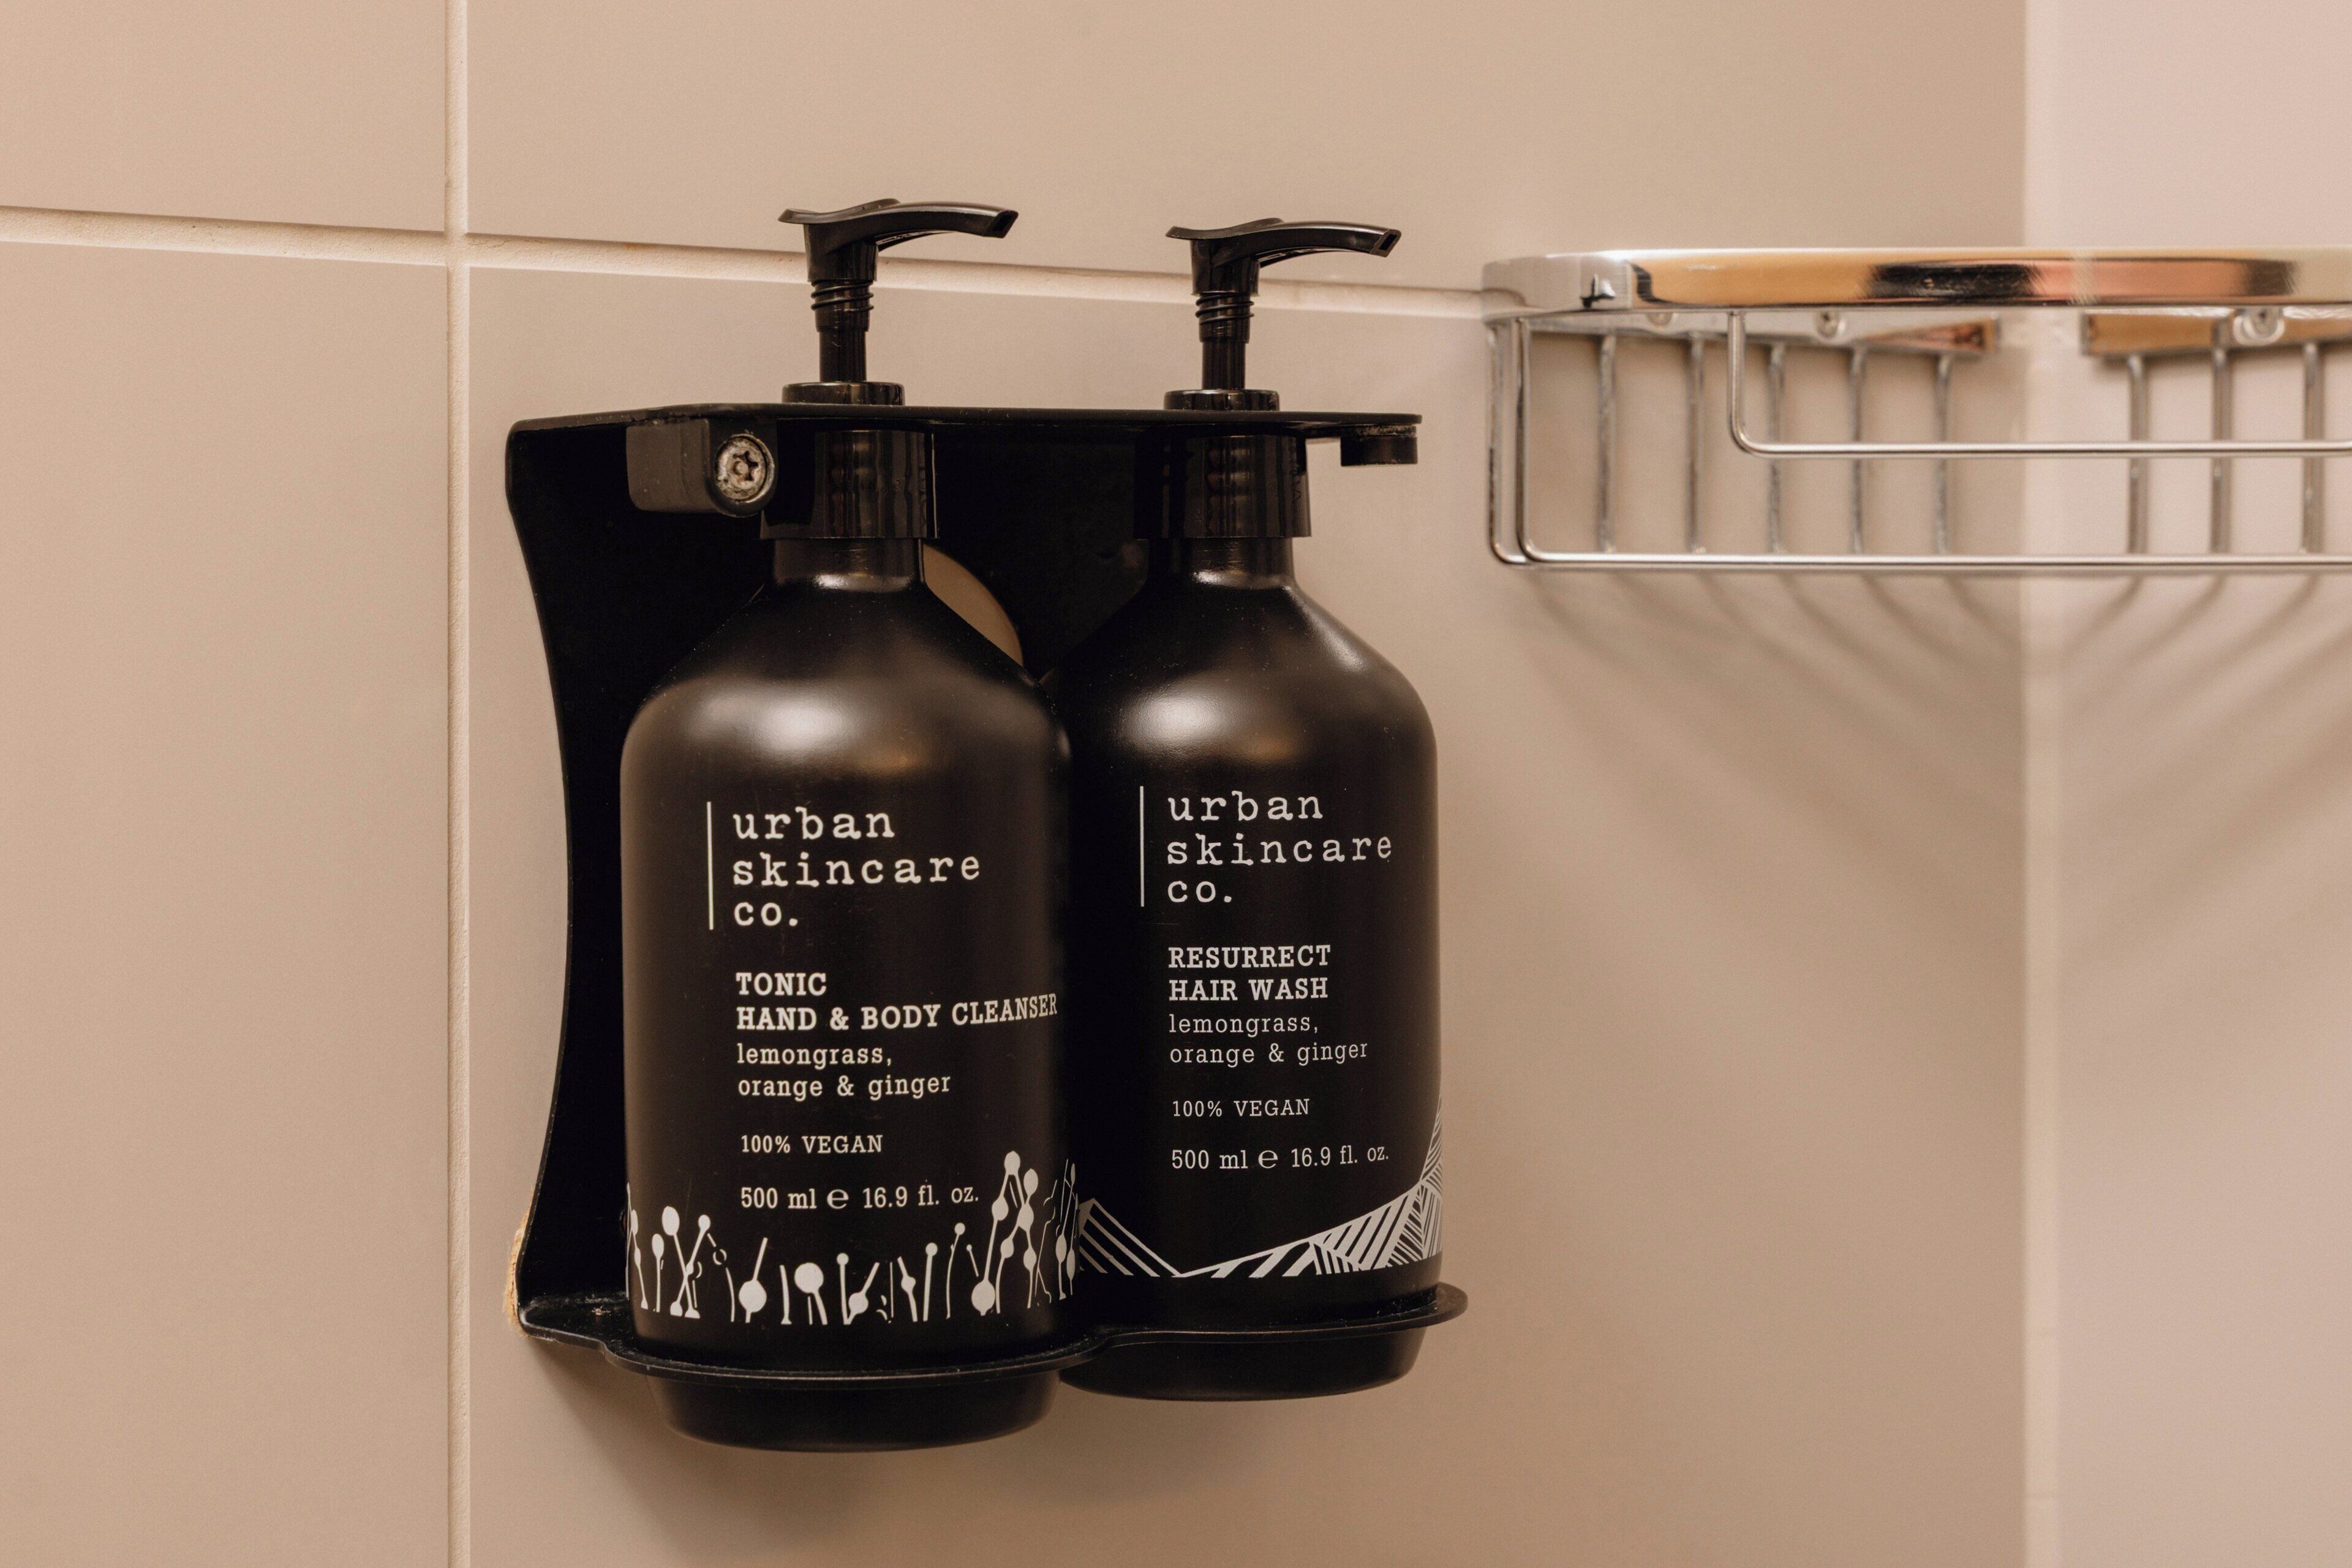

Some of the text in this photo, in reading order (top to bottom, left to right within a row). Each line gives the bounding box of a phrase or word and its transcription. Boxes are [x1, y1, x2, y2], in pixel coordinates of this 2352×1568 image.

[1167, 790, 1323, 821] urban
[732, 806, 895, 840] urban
[1166, 832, 1392, 865] skincare
[732, 851, 979, 888] skincare
[1167, 880, 1232, 903] co.
[733, 902, 798, 927] co.
[1167, 944, 1331, 968] RESURRECT
[735, 972, 827, 997] TONIC
[1168, 977, 1328, 1001] HAIR WASH
[736, 993, 1057, 1031] HAND & BODY CLEANSER
[1168, 1014, 1317, 1038] lemongrass,
[736, 1042, 891, 1070] lemongrass,
[1169, 1042, 1368, 1068] orange & ginger
[737, 1074, 951, 1102] orange & ginger
[1172, 1098, 1310, 1117] 100% VEGAN
[741, 1134, 883, 1154] 100% VEGAN
[1171, 1149, 1209, 1169] 500
[1218, 1150, 1248, 1169] ml
[1291, 1146, 1331, 1167] 16.9
[1339, 1145, 1358, 1164] fl.
[1366, 1146, 1389, 1162] oz.
[741, 1186, 778, 1209] 500
[787, 1188, 817, 1209] ml
[862, 1186, 908, 1208] 16.9
[917, 1185, 940, 1206] fl.
[950, 1186, 979, 1204] oz.
